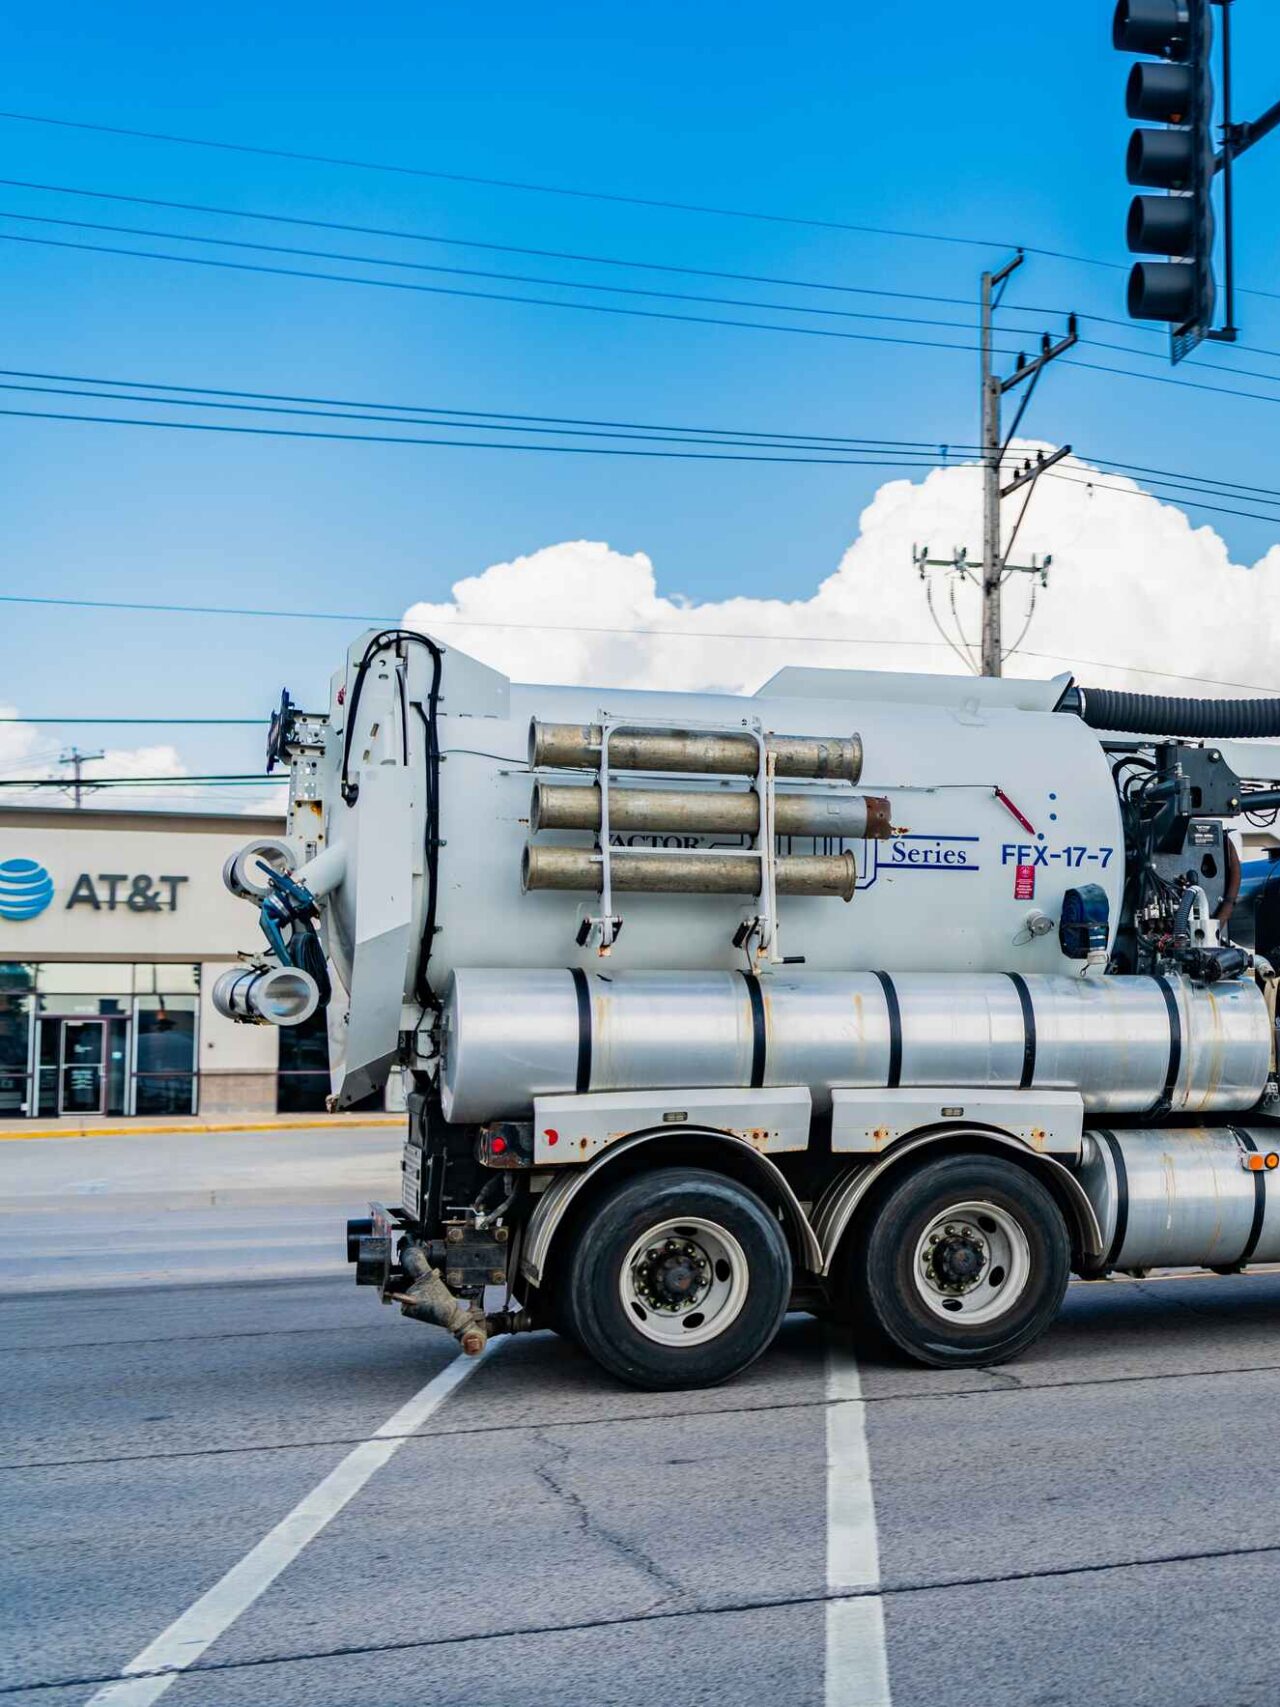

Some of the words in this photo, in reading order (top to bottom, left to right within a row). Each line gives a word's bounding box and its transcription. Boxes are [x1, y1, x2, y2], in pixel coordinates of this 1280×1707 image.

[609, 834, 700, 849] ACTOR
[892, 841, 966, 864] Series
[1001, 844, 1114, 868] FFX-17-7
[65, 873, 189, 912] AT&T
